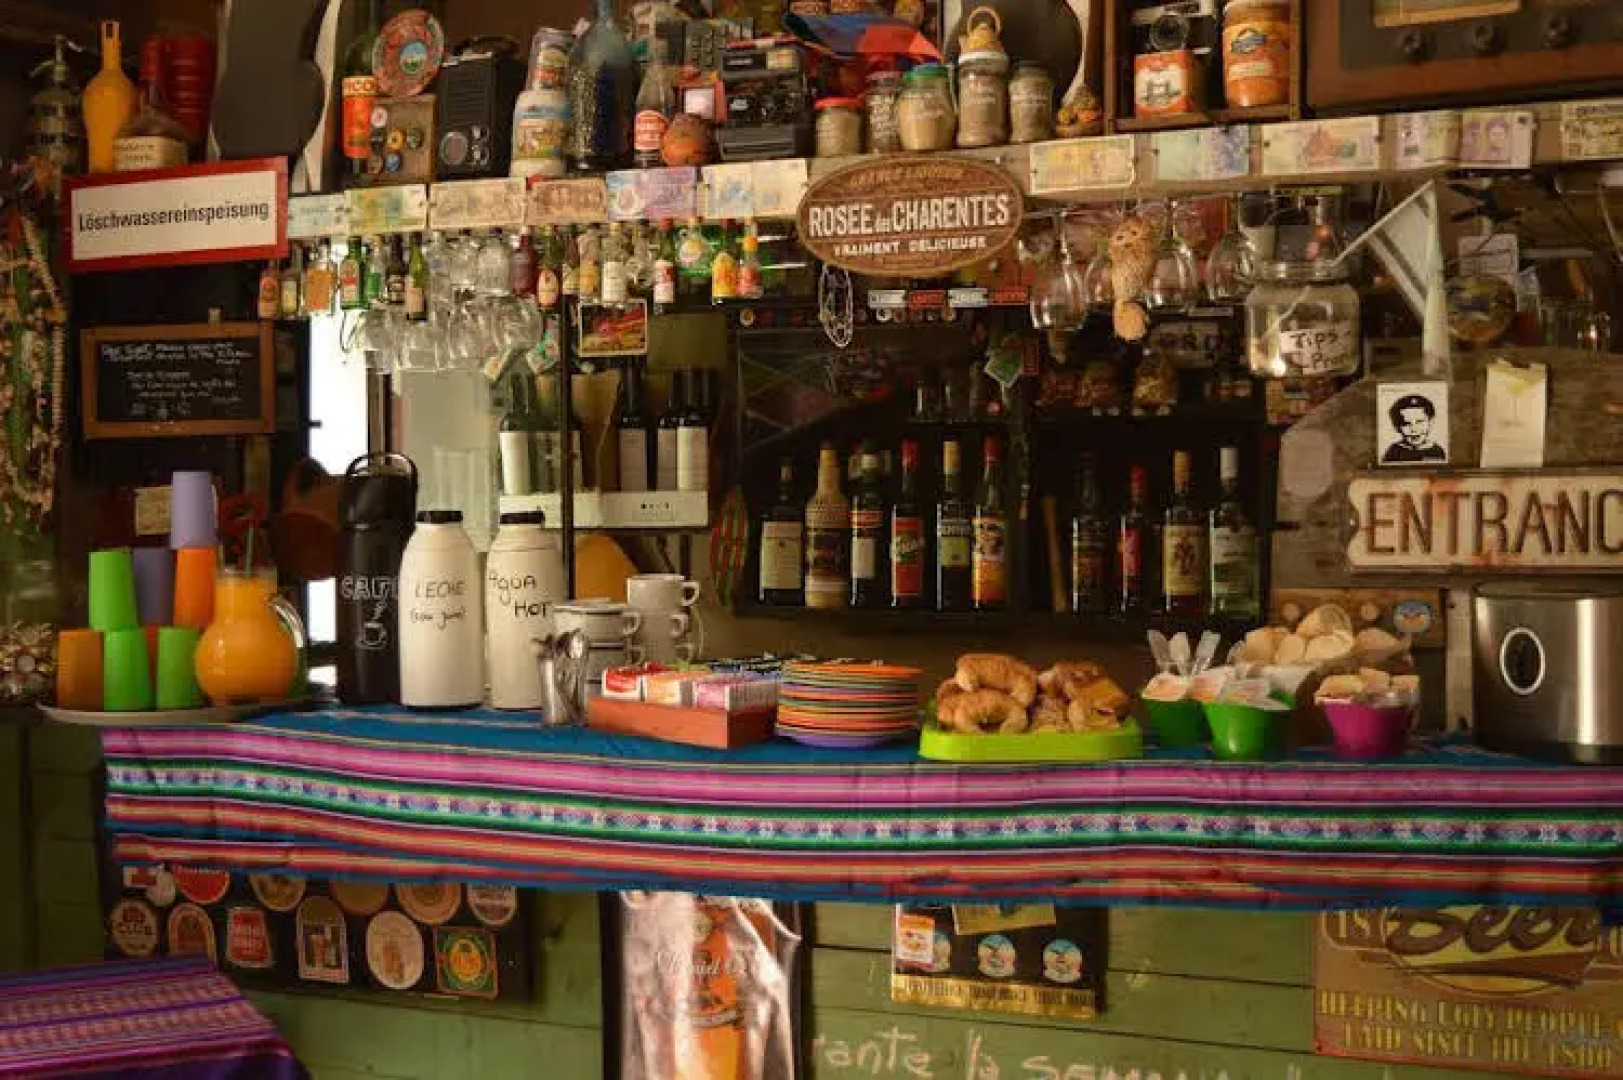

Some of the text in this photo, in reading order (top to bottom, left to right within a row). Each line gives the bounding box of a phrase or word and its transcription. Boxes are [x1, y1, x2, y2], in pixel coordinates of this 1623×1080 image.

[79, 200, 269, 232] Löschwassereinspeisung
[808, 204, 873, 237] ROSEE
[891, 195, 1009, 232] CHARENTES
[1366, 489, 1623, 556] ENTRANC
